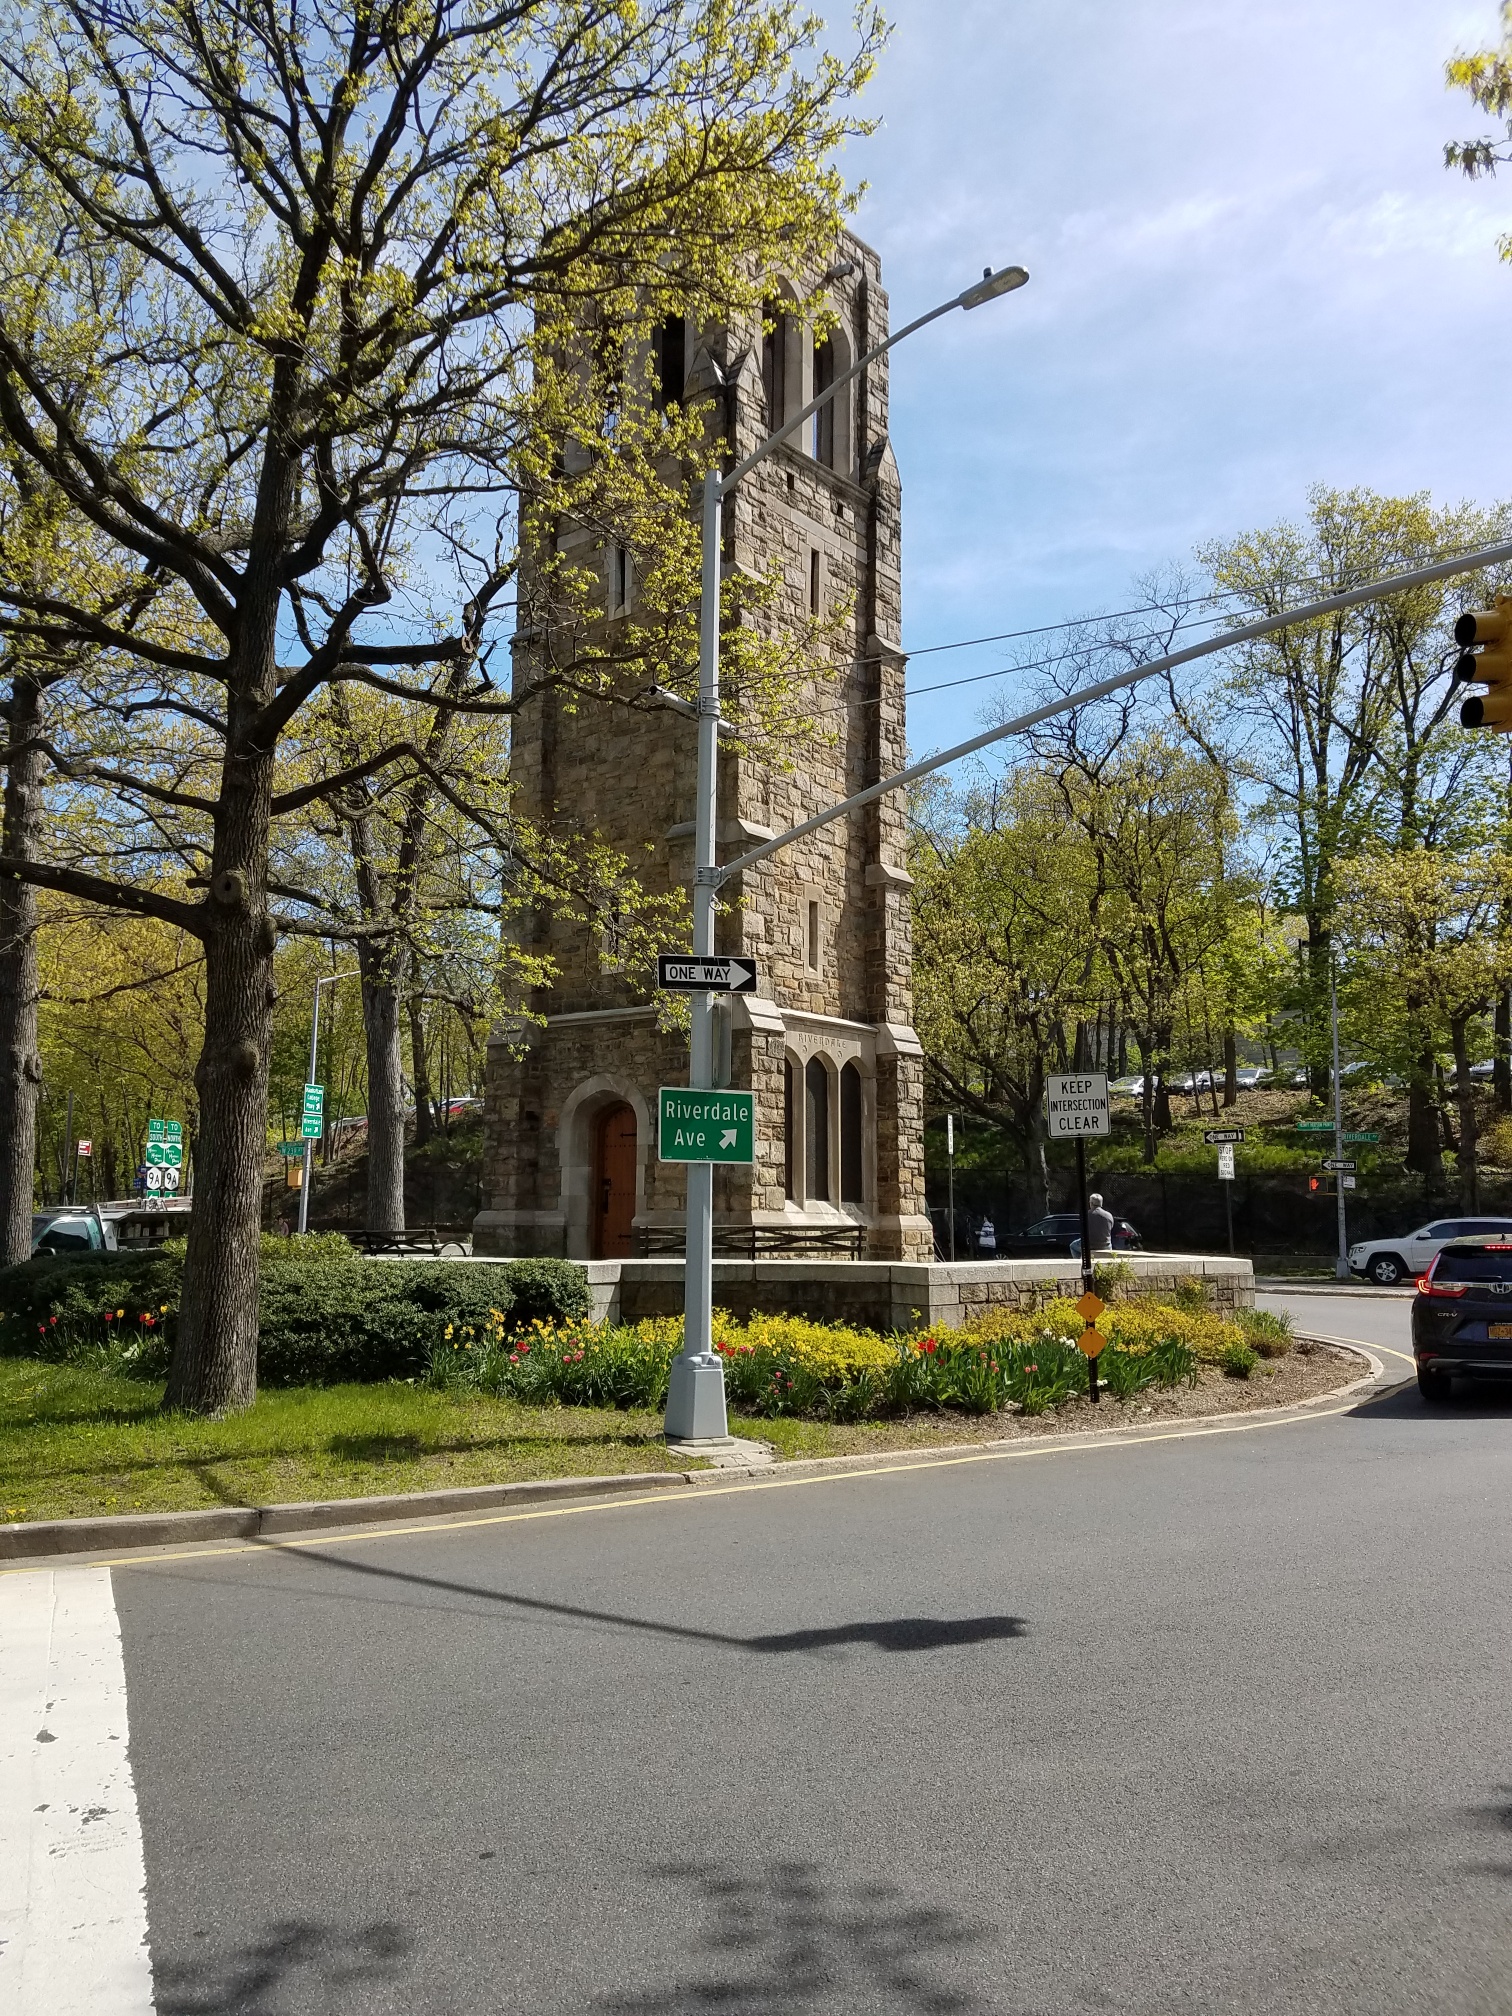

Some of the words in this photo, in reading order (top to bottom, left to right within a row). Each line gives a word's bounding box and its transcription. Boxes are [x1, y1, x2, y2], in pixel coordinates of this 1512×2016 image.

[669, 965, 697, 980] ONE
[703, 966, 731, 981] WAY
[798, 1033, 847, 1049] RIVERDALE
[1061, 1080, 1092, 1094] KEEP
[666, 1100, 748, 1121] Riverdale
[1050, 1098, 1106, 1112] INTERSECTION
[1059, 1116, 1099, 1130] CLEAR
[150, 1133, 163, 1141] SOUTH
[167, 1134, 181, 1142] NORTH
[674, 1128, 706, 1147] Ave
[1219, 1146, 1232, 1155] STOP
[149, 1172, 160, 1185] 9A
[166, 1172, 177, 1185] 9A
